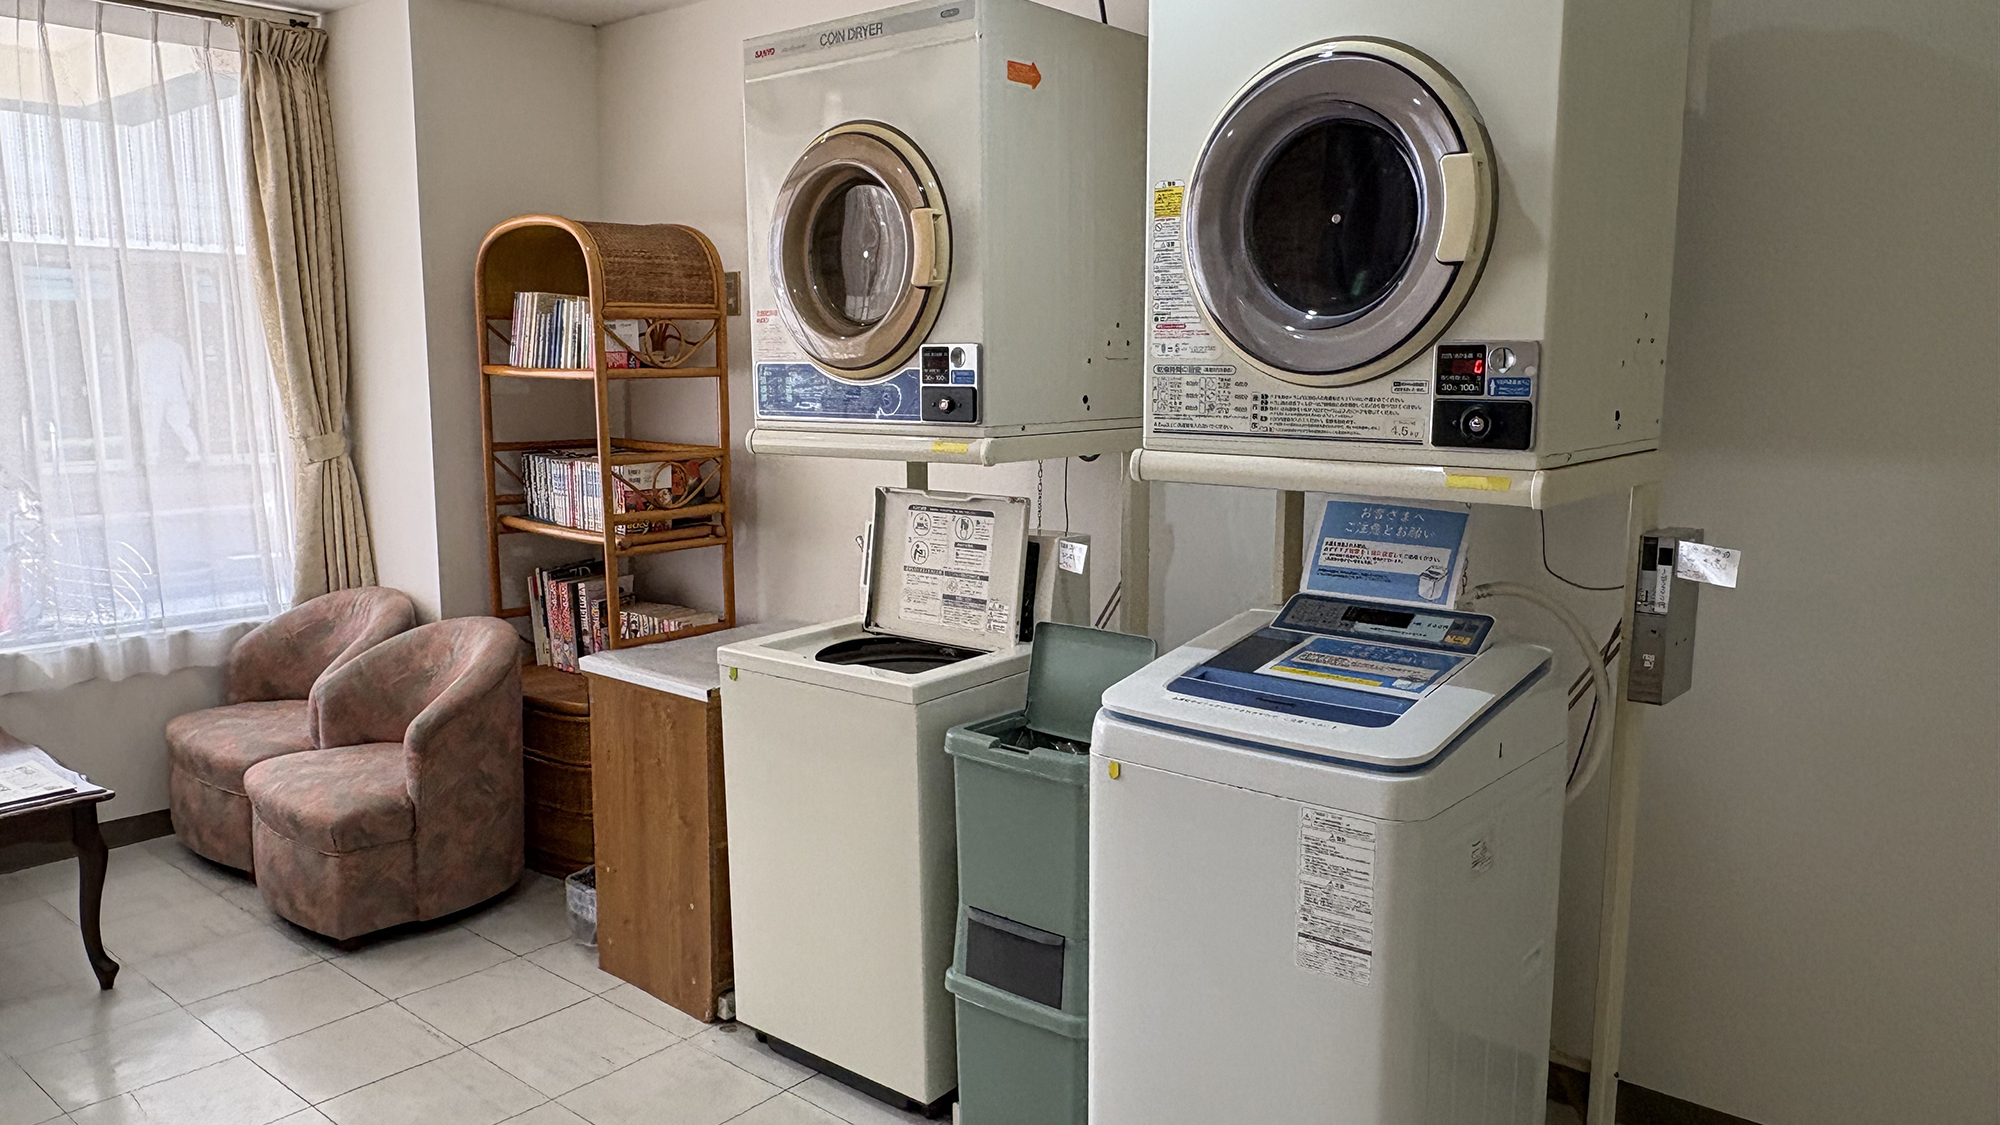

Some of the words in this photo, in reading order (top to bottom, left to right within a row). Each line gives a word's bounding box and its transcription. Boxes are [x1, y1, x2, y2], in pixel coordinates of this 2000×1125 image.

[819, 29, 845, 47] COIN
[847, 22, 883, 41] DRYER
[1360, 507, 1425, 522] お客さまへ
[1345, 521, 1436, 539] ご注意とお願い
